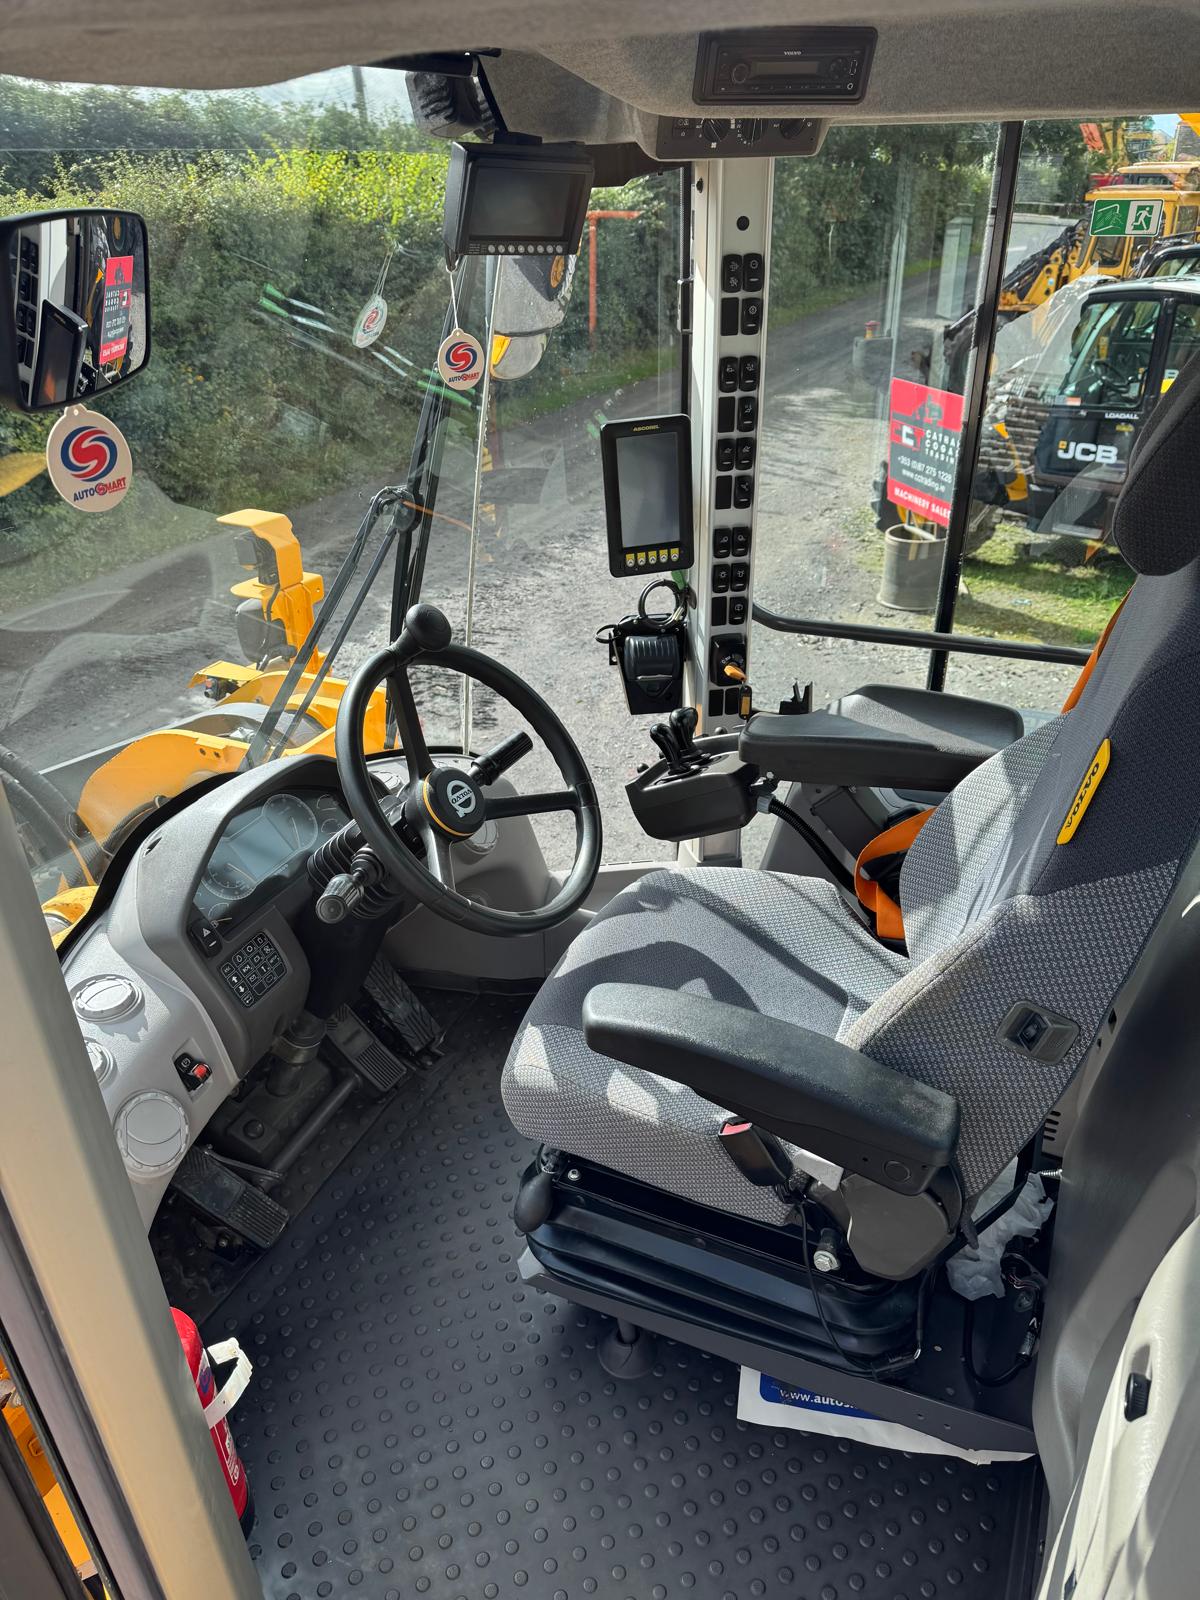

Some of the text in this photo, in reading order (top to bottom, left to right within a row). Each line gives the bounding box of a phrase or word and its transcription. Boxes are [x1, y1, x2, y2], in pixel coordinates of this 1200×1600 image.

[1105, 412, 1139, 420] LOADALL
[925, 448, 955, 464] TRADIN
[1057, 440, 1119, 464] JCB
[894, 487, 930, 510] MACHINERY
[1065, 762, 1099, 829] VOLVO
